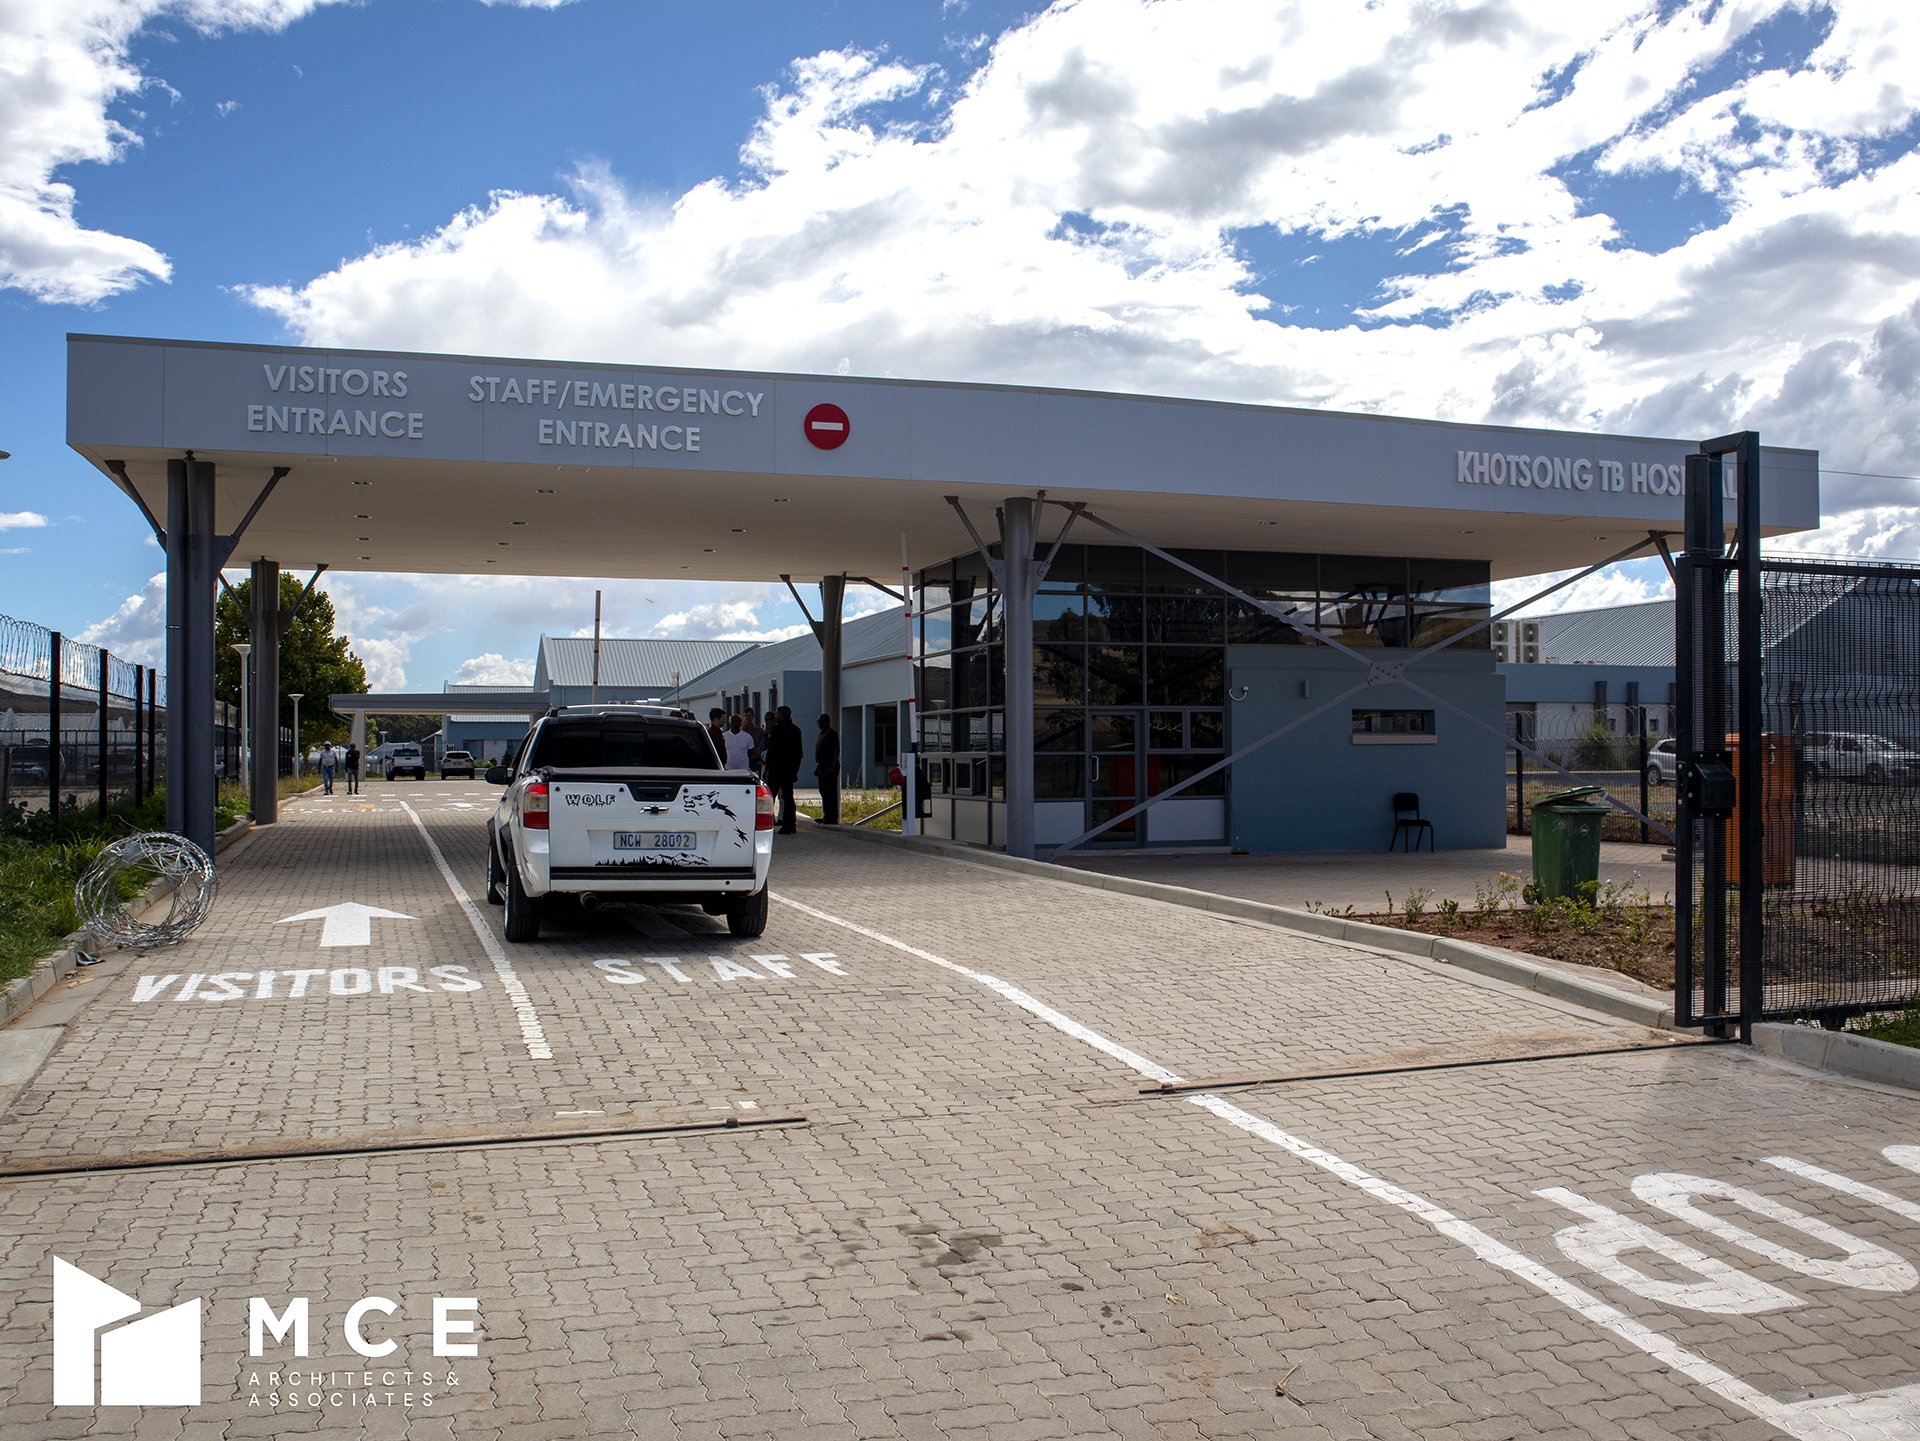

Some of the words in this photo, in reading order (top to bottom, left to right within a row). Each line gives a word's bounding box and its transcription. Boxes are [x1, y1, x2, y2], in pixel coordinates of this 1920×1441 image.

[264, 364, 408, 398] VISITORS
[468, 375, 765, 417] STAFF/EMERGENCY
[247, 405, 424, 440] ENTRANCE
[538, 419, 700, 452] ENTRANCE
[1457, 450, 1593, 491] KHOTSONG
[1599, 460, 1625, 492] TB
[1631, 462, 1739, 499] HOSL
[565, 794, 616, 806] WOLF
[620, 834, 641, 847] NCW
[654, 834, 690, 847] 28092
[131, 964, 484, 1002] VISITORS
[593, 952, 850, 985] STAFF
